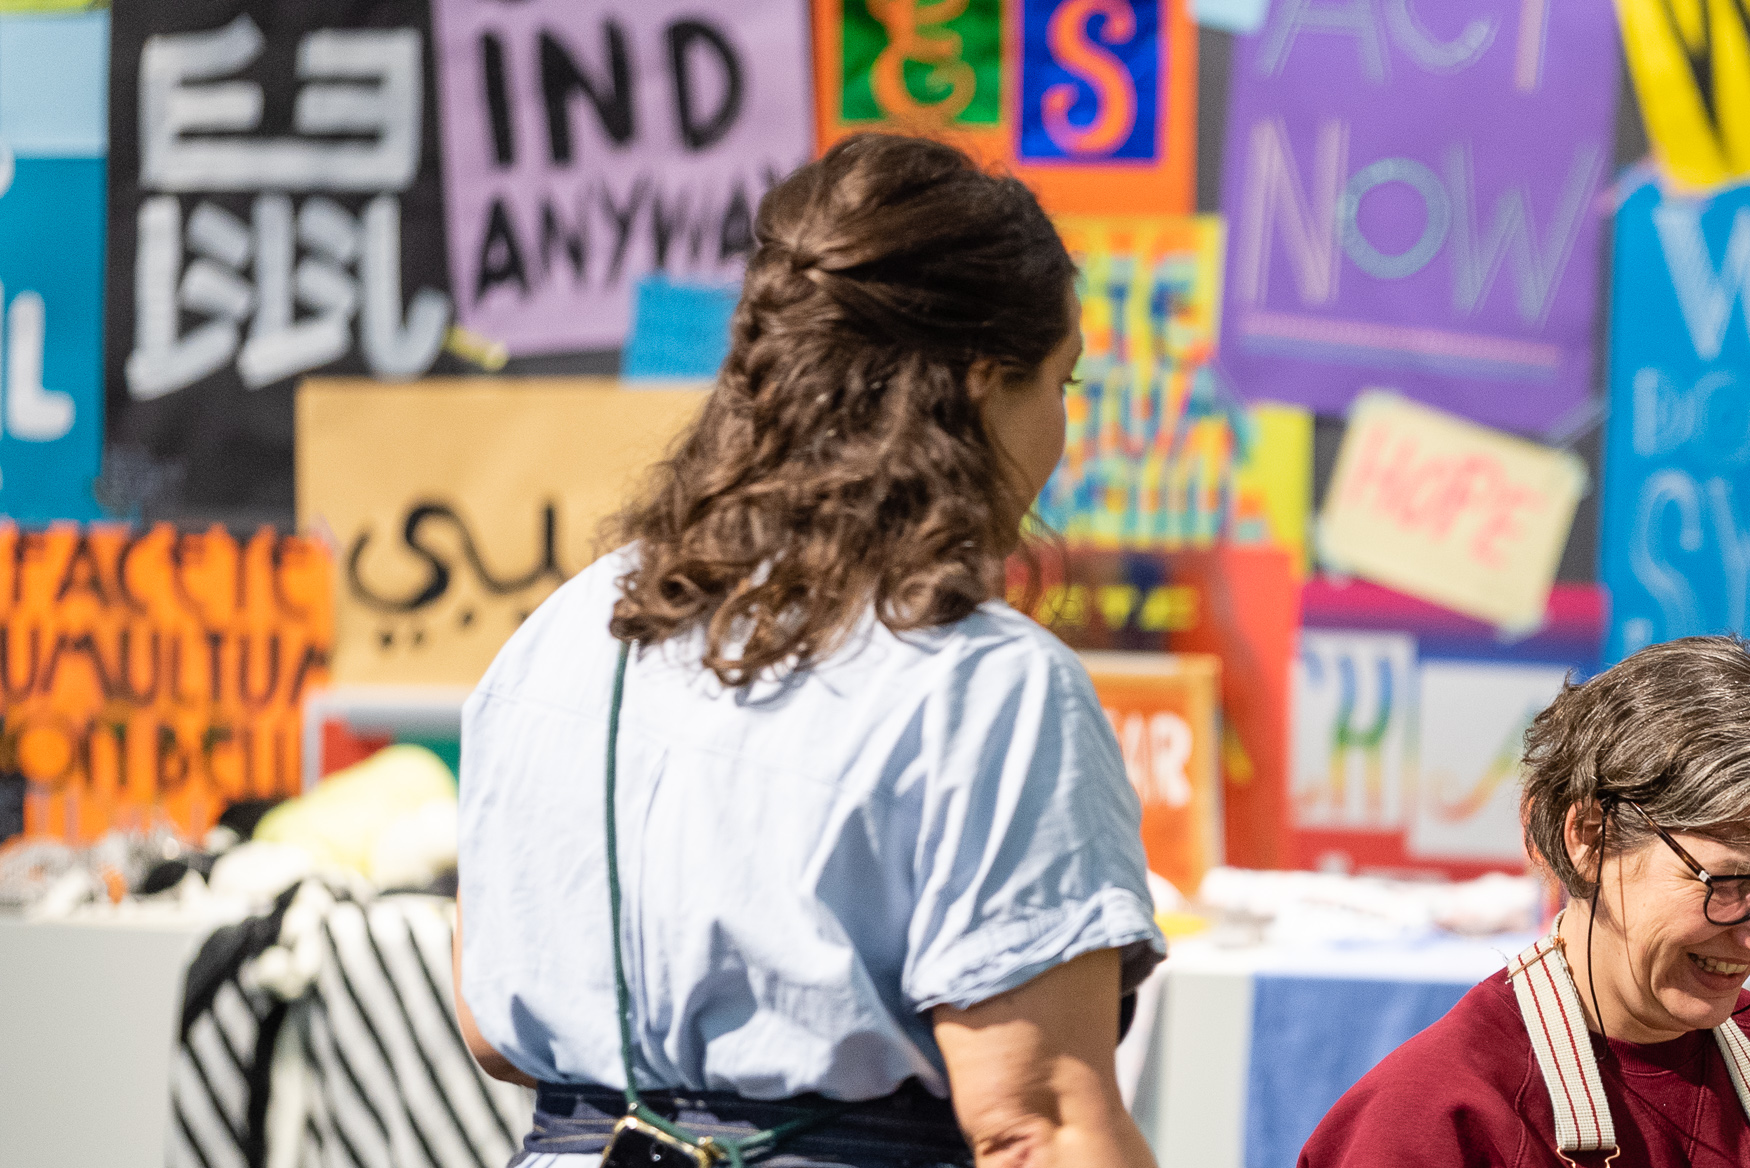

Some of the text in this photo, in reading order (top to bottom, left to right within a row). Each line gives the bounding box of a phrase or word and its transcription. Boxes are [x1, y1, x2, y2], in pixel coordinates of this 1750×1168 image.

[478, 17, 746, 170] IND
[472, 163, 782, 306] ANYWA
[1236, 116, 1610, 328] NOW
[1343, 419, 1548, 571] HOPE
